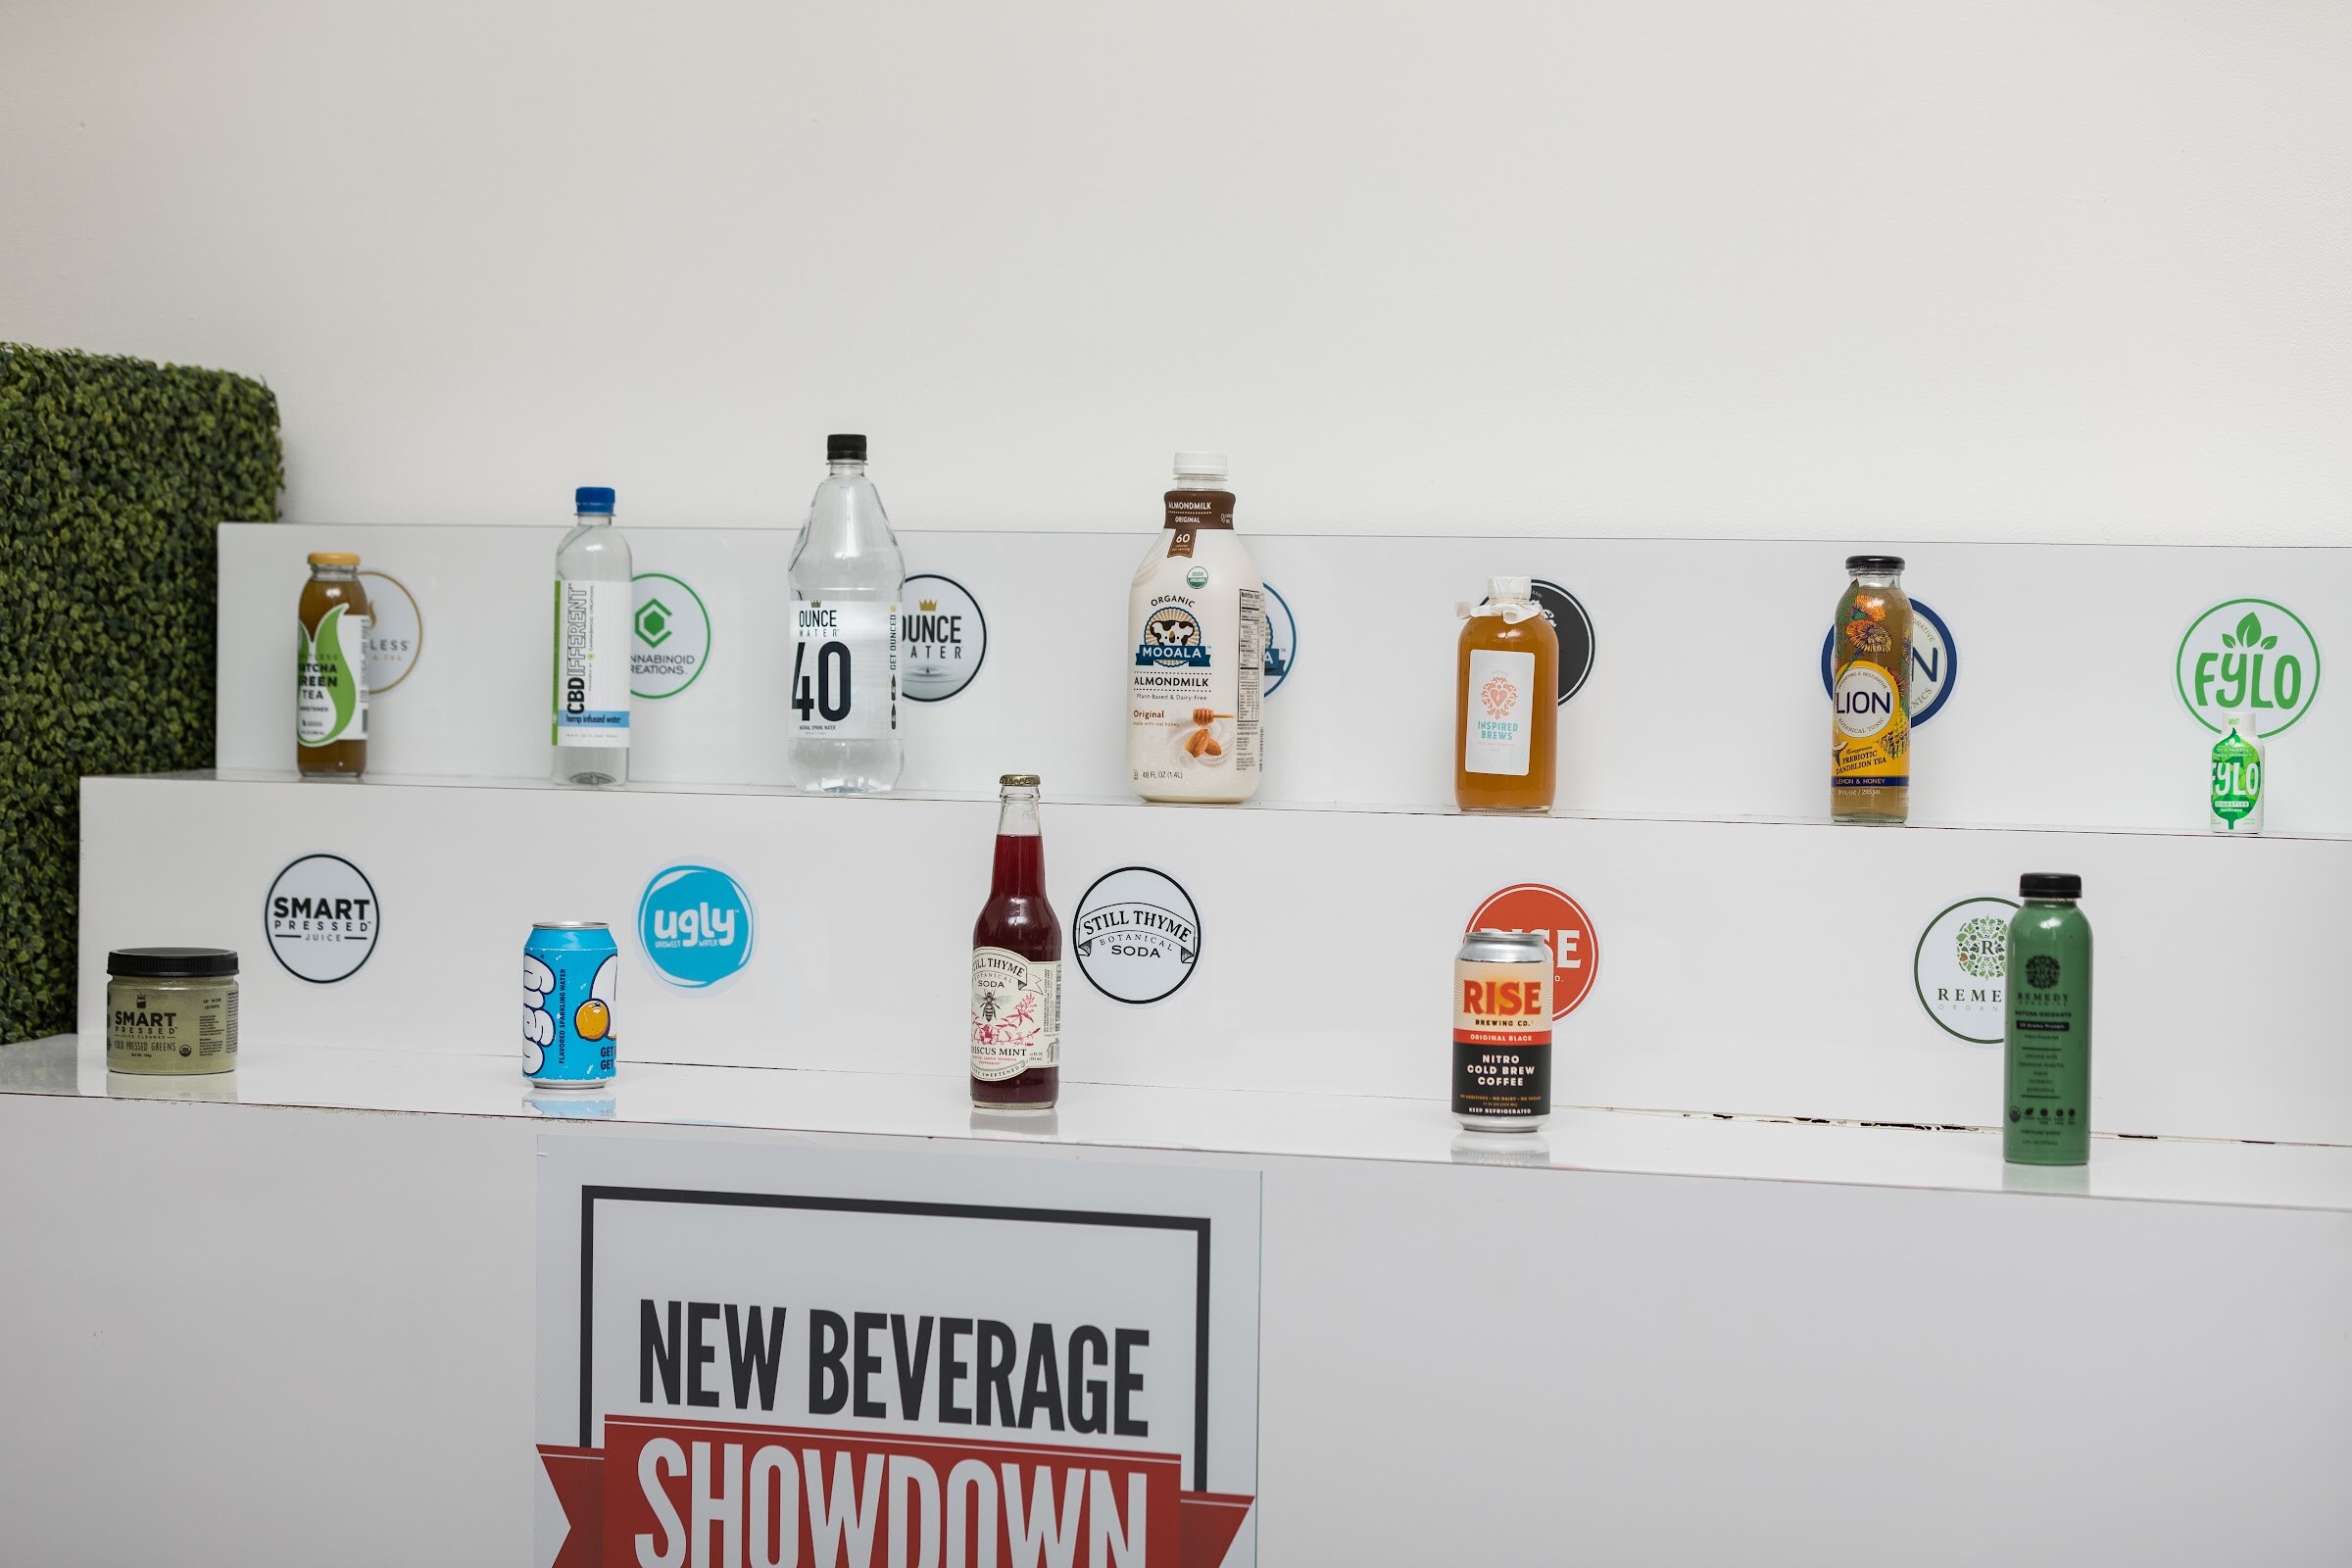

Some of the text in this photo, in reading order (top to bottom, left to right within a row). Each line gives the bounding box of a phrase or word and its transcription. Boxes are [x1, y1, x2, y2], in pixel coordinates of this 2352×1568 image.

[1168, 501, 1211, 510] ALMONDMILK
[1176, 533, 1191, 543] 60
[1151, 595, 1196, 608] ORGANIC
[799, 610, 837, 627] OUNCE
[369, 639, 408, 652] LESS
[903, 645, 961, 659] ATER
[1143, 647, 1201, 658] MOOALA
[631, 655, 695, 663] NNABINOID
[630, 664, 684, 674] REATIONS
[298, 676, 338, 687] REEN
[791, 641, 852, 721] 40
[1134, 676, 1209, 687] ALMONDMILK
[2194, 652, 2302, 710] FYLO
[302, 689, 324, 700] TEA
[1911, 687, 1933, 709] NICS
[1836, 691, 1890, 714] LION
[565, 713, 581, 724] hemp
[583, 713, 605, 723] infused
[1133, 710, 1165, 720] Original
[1477, 720, 1518, 732] INSPIRED
[1867, 717, 1885, 732] TONIC
[1481, 731, 1513, 741] BREWS
[1842, 750, 1878, 764] PREBIOTIC
[1836, 756, 1886, 775] DANDELION TEA
[273, 897, 370, 920] SMART
[274, 920, 368, 932] PRESSED
[654, 902, 735, 948] ugly
[1083, 910, 1192, 943] STILL THYME
[1100, 934, 1173, 952] BOTANICAL
[1111, 945, 1161, 958] SODA
[972, 957, 1025, 977] TILL THYME
[1463, 980, 1542, 1016] RISE
[1937, 988, 2002, 1003] REME
[2017, 992, 2069, 1002] REMEDY
[115, 1010, 176, 1027] SMART
[115, 1026, 175, 1035] PRESSED
[125, 1041, 148, 1052] PRESSED
[151, 1042, 176, 1052] GREENS
[600, 1046, 614, 1057] GET
[971, 1045, 1028, 1056] BISCUS MINT
[600, 1058, 614, 1070] GET
[1482, 1054, 1520, 1064] NITRO
[981, 1066, 1020, 1077] SWEETENED
[1467, 1064, 1536, 1075] COLD BREW
[1477, 1076, 1524, 1087] COFFEE
[639, 1298, 1151, 1438] NEW BEVERAGE
[633, 1437, 1149, 1568] SHOWDOWN
